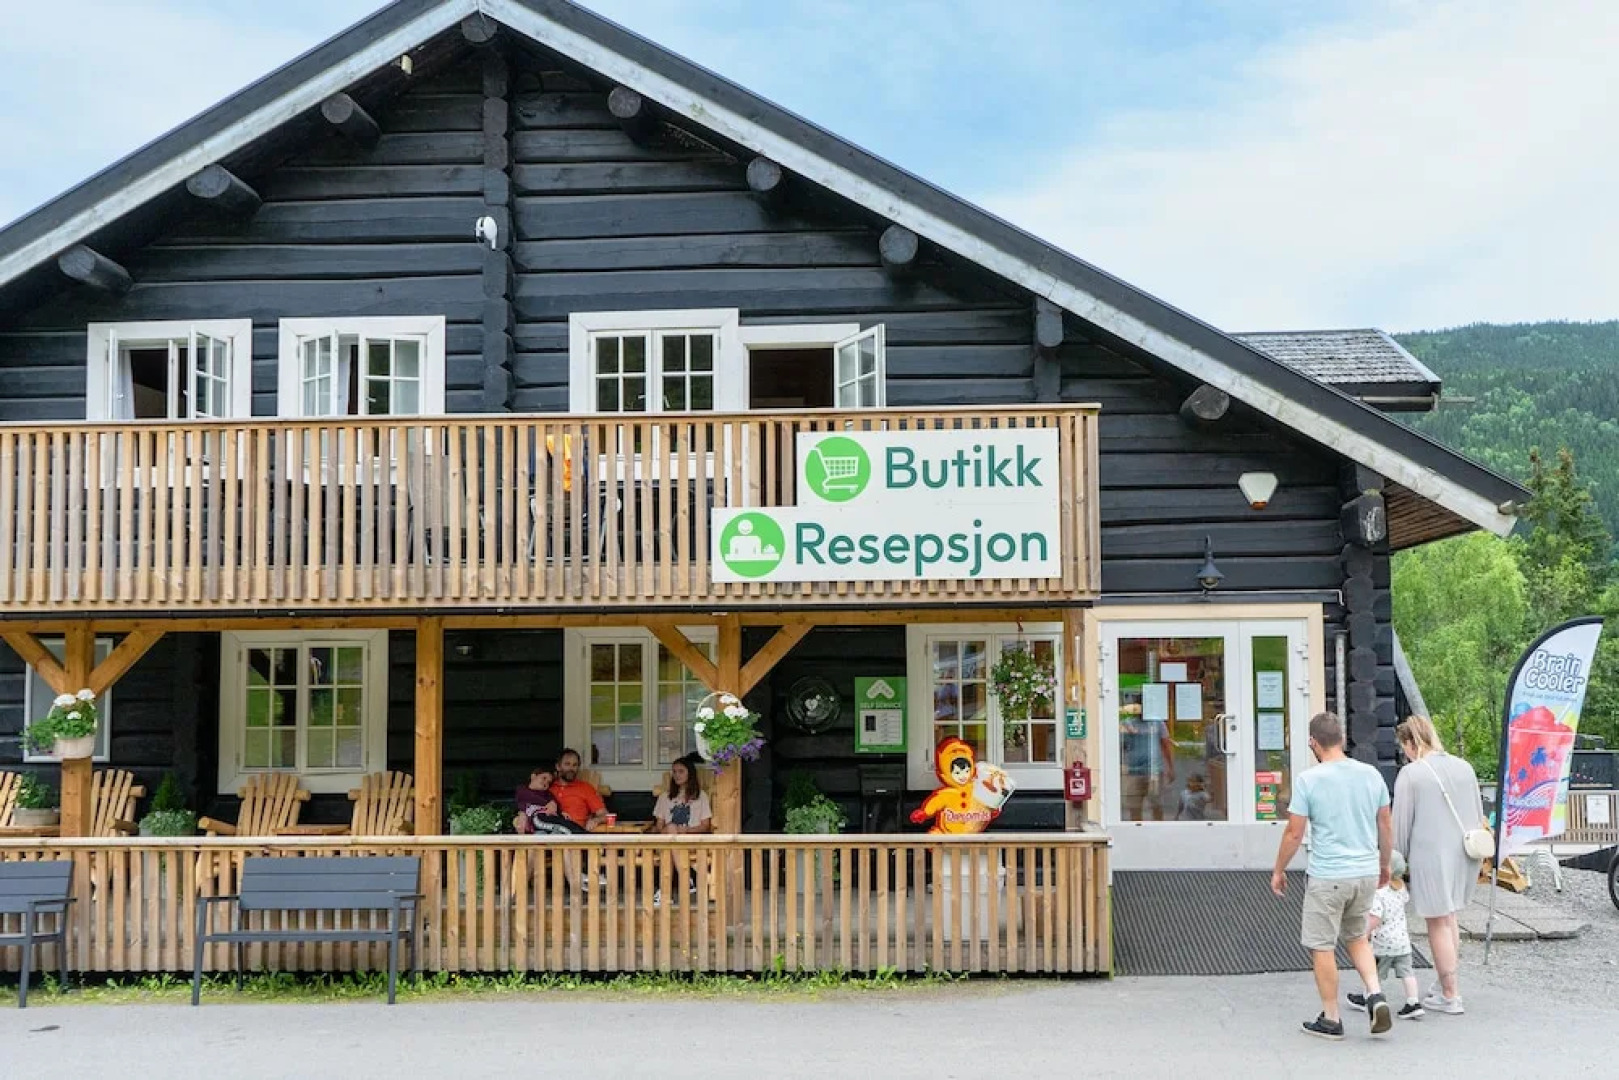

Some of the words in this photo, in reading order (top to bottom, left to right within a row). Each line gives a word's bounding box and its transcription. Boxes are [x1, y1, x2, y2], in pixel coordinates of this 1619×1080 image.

[885, 445, 1043, 489] Butikk
[795, 519, 1048, 576] Resepsjon
[1525, 667, 1586, 693] Cooler
[1533, 649, 1582, 676] Brain
